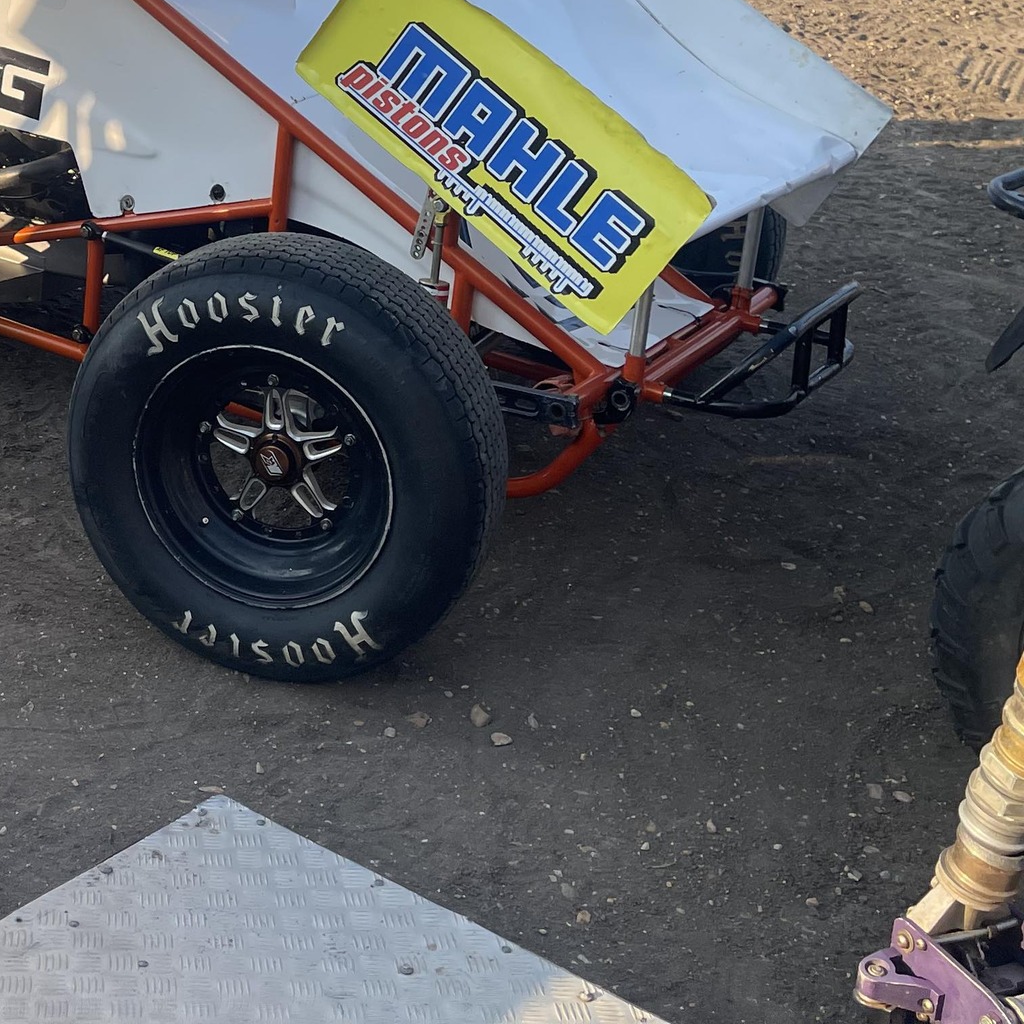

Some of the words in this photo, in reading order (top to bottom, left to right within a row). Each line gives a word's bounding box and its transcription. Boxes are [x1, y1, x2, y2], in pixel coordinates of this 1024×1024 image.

[338, 62, 470, 174] pistons
[377, 22, 647, 272] MAHLE
[136, 285, 346, 357] Hoosier
[174, 609, 382, 668] Hoosier
